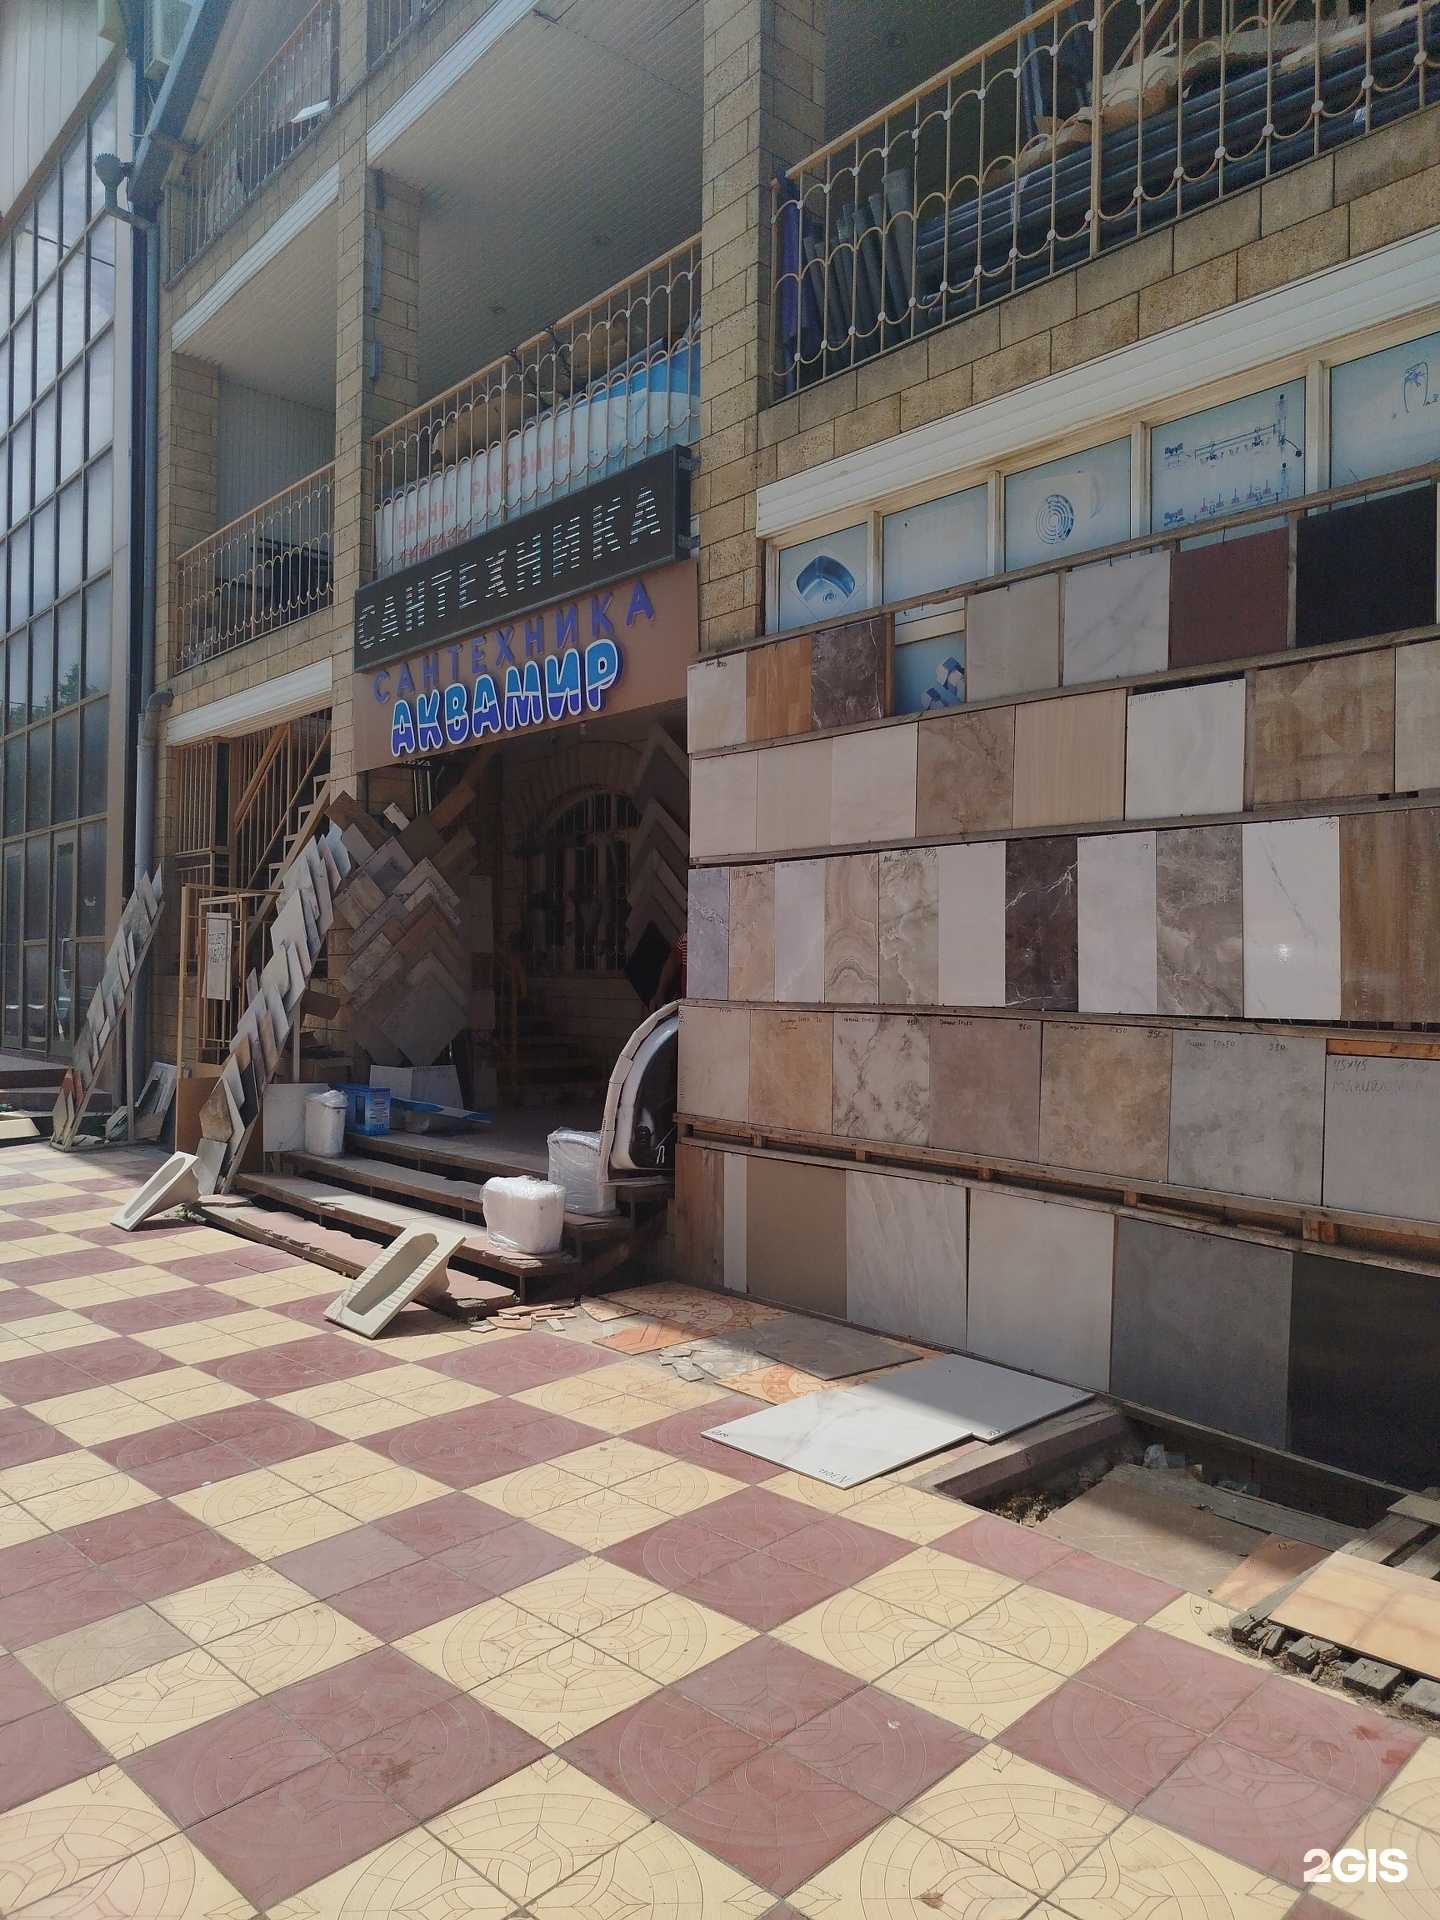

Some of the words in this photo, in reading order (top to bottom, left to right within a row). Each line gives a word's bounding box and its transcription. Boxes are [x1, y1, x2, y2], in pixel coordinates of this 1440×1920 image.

[358, 486, 662, 650] САНТЕХНИКА
[371, 577, 656, 704] САНТЕХНИКА
[391, 638, 620, 758] АКВАМИР
